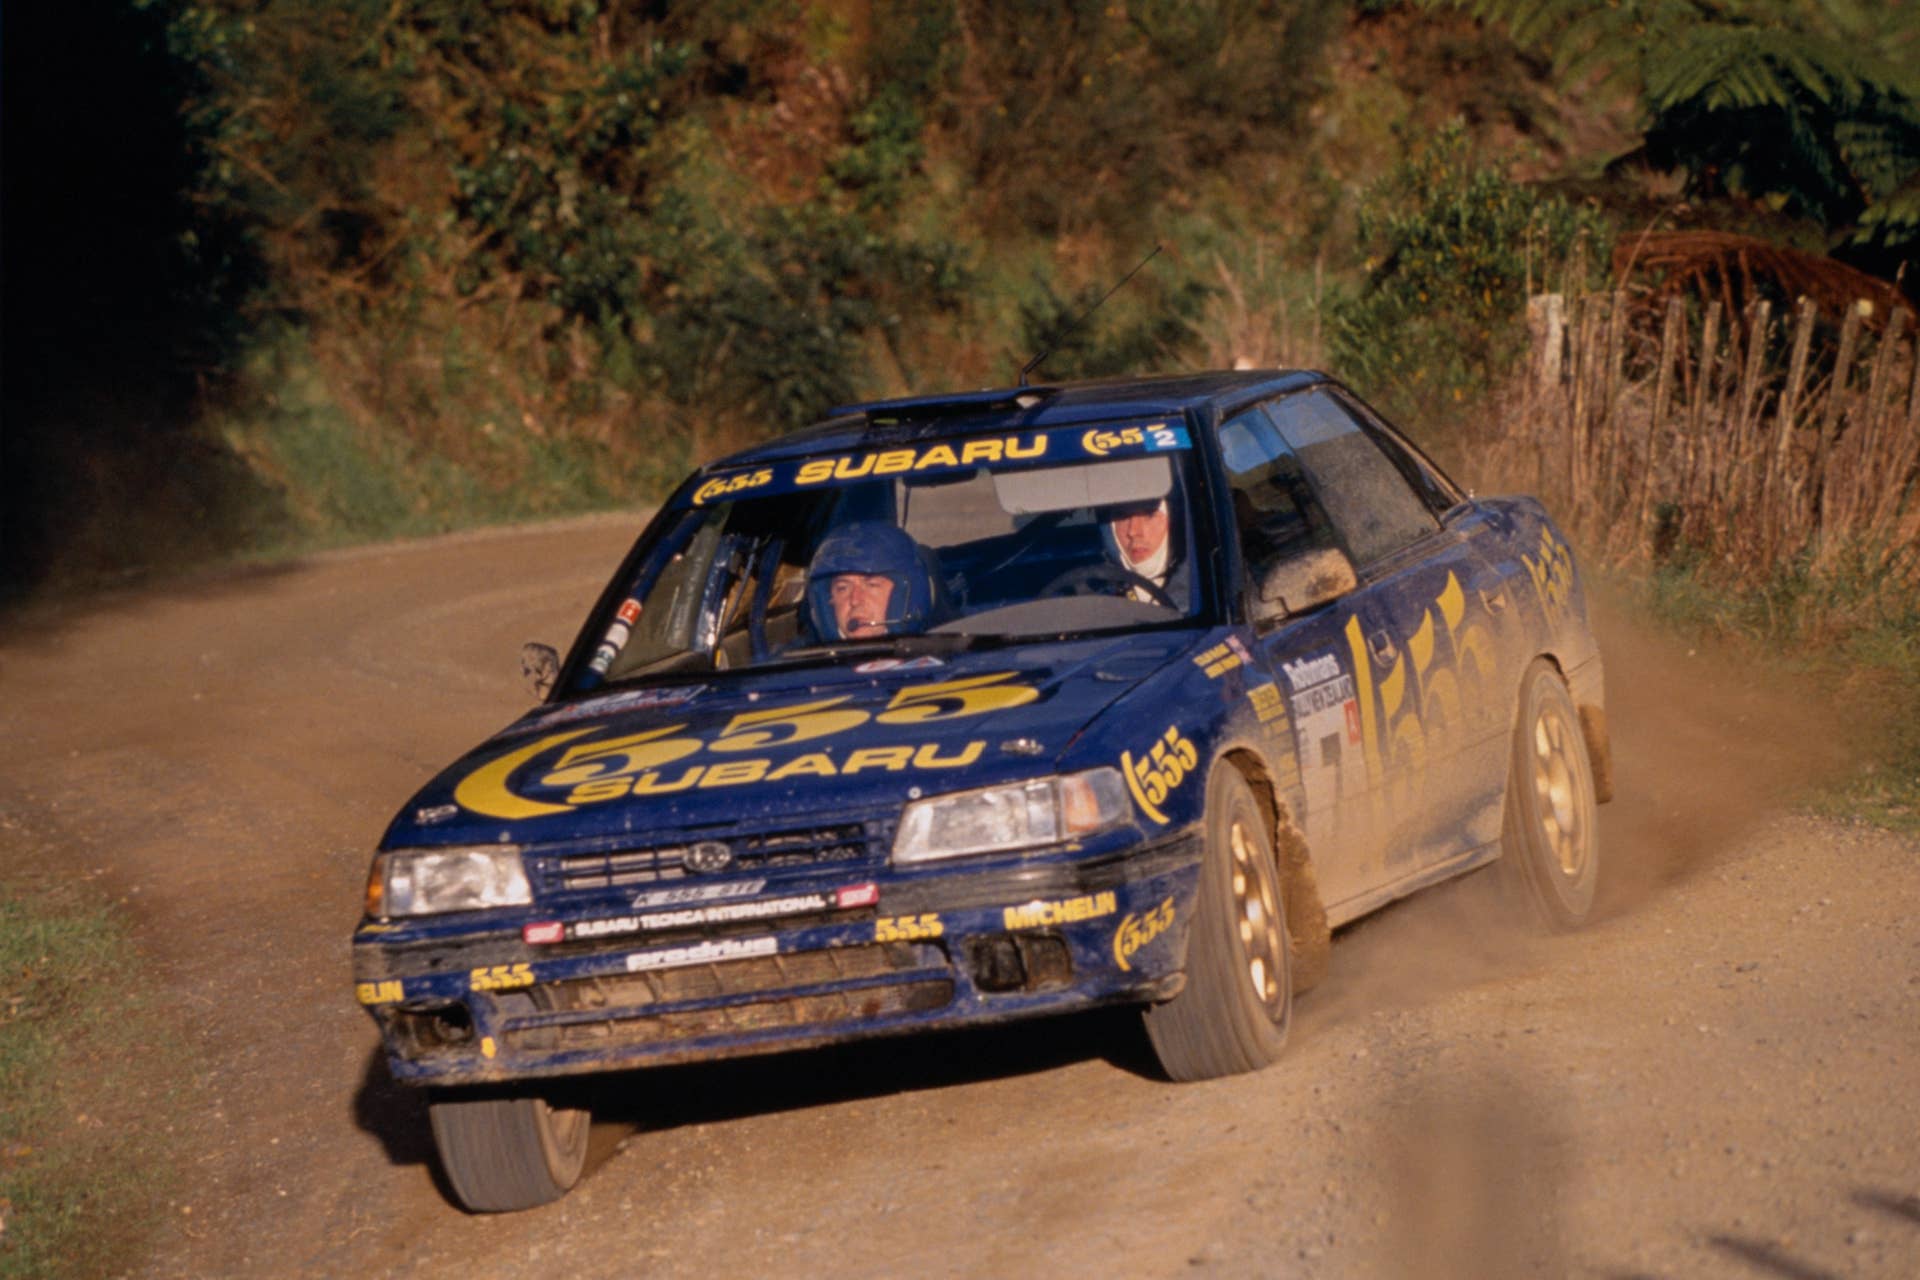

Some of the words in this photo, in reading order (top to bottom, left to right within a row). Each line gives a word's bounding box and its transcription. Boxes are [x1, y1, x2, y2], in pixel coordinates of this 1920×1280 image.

[1153, 429, 1178, 447] 2
[795, 435, 1048, 485] SUBARU
[525, 672, 1040, 792] 555
[566, 741, 987, 804] SUBARU
[1130, 725, 1198, 810] 555
[575, 916, 639, 937] SUBARU
[640, 909, 704, 930] TECNICA
[706, 894, 827, 922] INTERNATIONAL
[874, 913, 944, 942] 555
[1003, 891, 1117, 930] MICHELIN
[469, 963, 536, 992] 555
